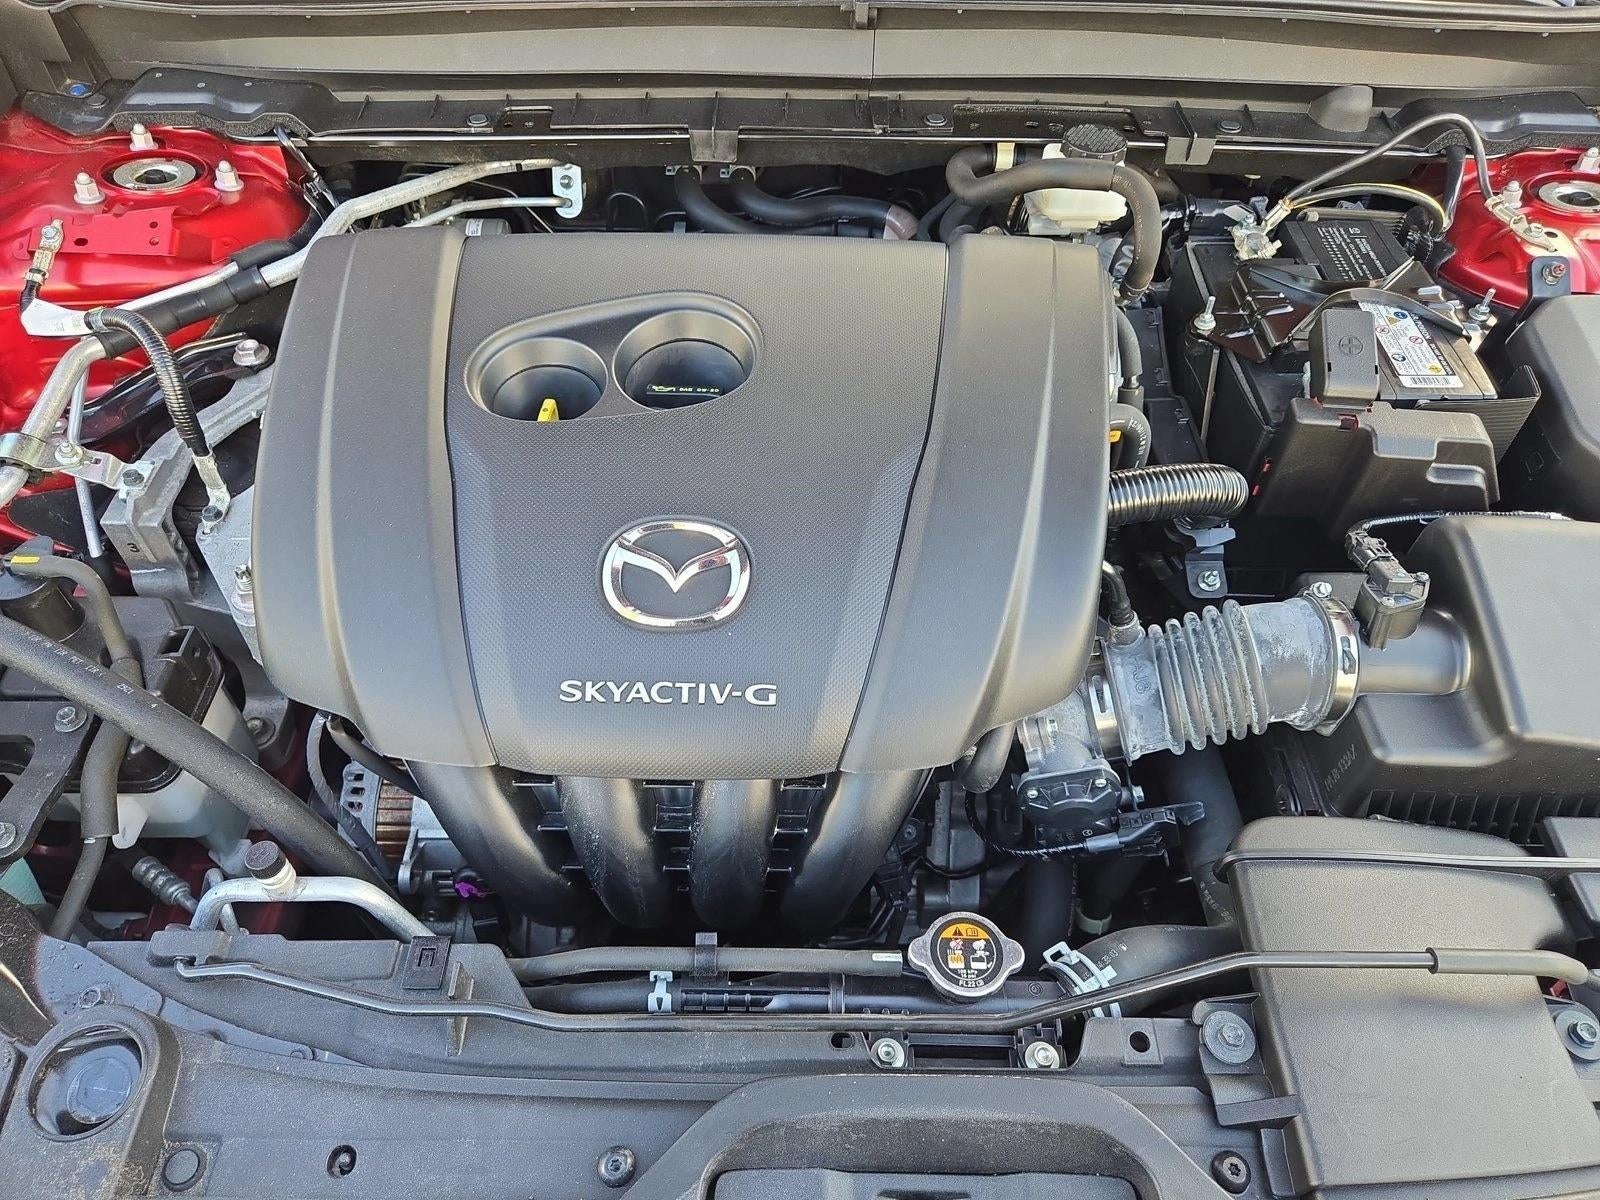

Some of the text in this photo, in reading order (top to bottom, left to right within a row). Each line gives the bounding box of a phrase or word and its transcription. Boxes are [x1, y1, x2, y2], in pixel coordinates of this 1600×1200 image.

[126, 542, 141, 553] 3
[559, 679, 778, 706] SKYACTIV-G
[959, 979, 976, 987] FL22
